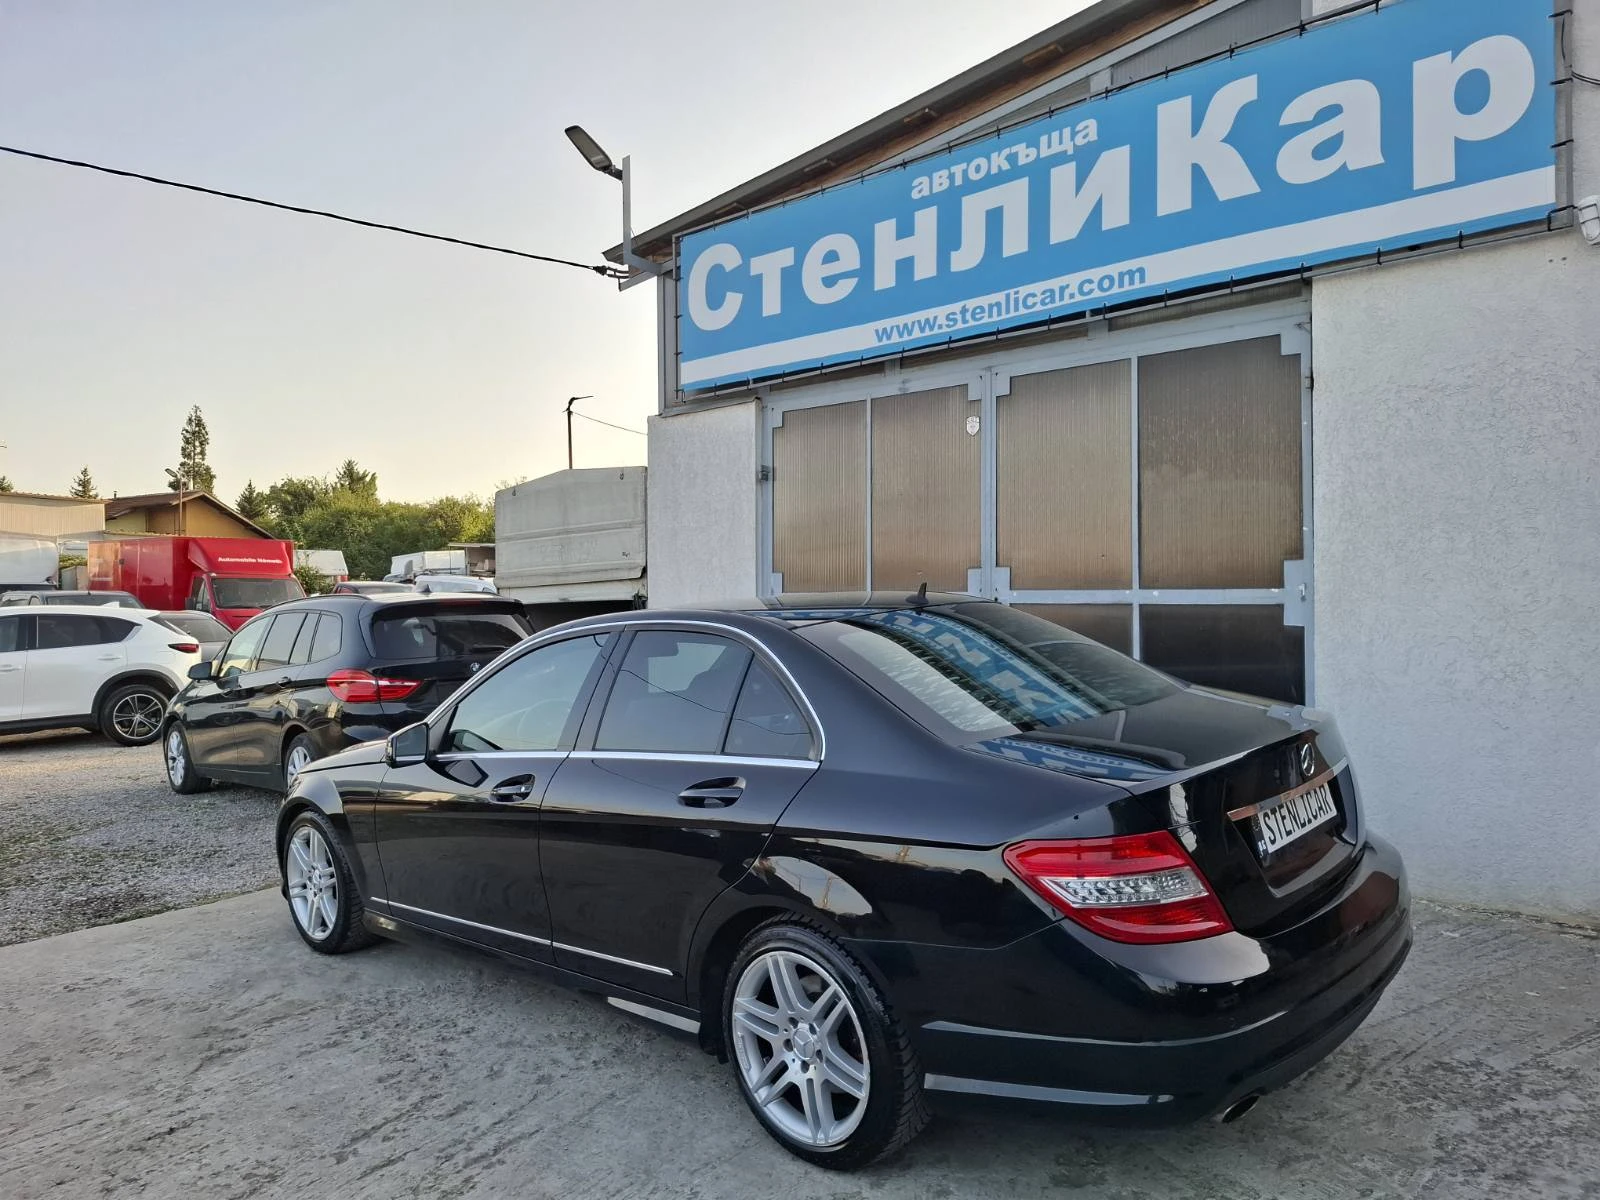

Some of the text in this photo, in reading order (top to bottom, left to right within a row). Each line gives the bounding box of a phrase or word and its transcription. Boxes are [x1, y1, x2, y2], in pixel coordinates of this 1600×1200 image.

[688, 34, 1536, 331] СтенлиКар
[911, 118, 1098, 200] автокъща
[874, 266, 1146, 343] www.stenlicar.com
[1263, 784, 1333, 845] STENLICAR
